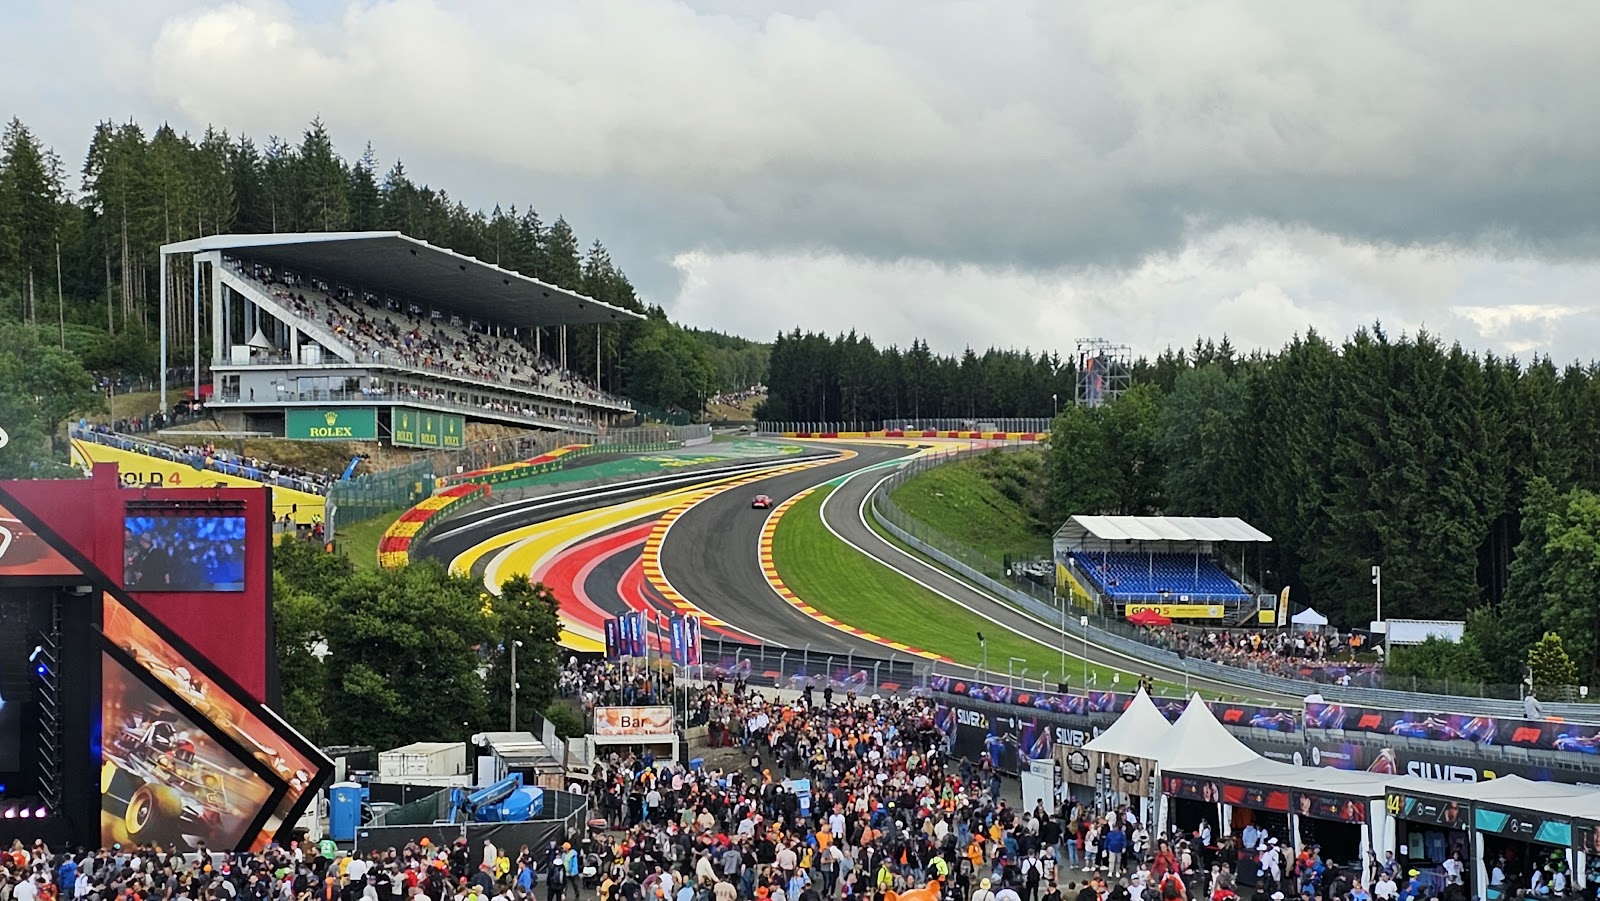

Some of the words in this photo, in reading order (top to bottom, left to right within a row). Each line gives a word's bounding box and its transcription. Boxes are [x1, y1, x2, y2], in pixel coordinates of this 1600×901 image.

[310, 427, 352, 437] ROLEX
[396, 430, 414, 442] ROLEX
[421, 433, 437, 445] ROLEX
[444, 435, 460, 446] ROLEX
[168, 472, 182, 485] 4
[1163, 607, 1170, 615] 5
[621, 716, 645, 728] Bar
[957, 709, 980, 727] SILVER
[1056, 727, 1084, 746] SILVER
[1387, 794, 1400, 815] 44
